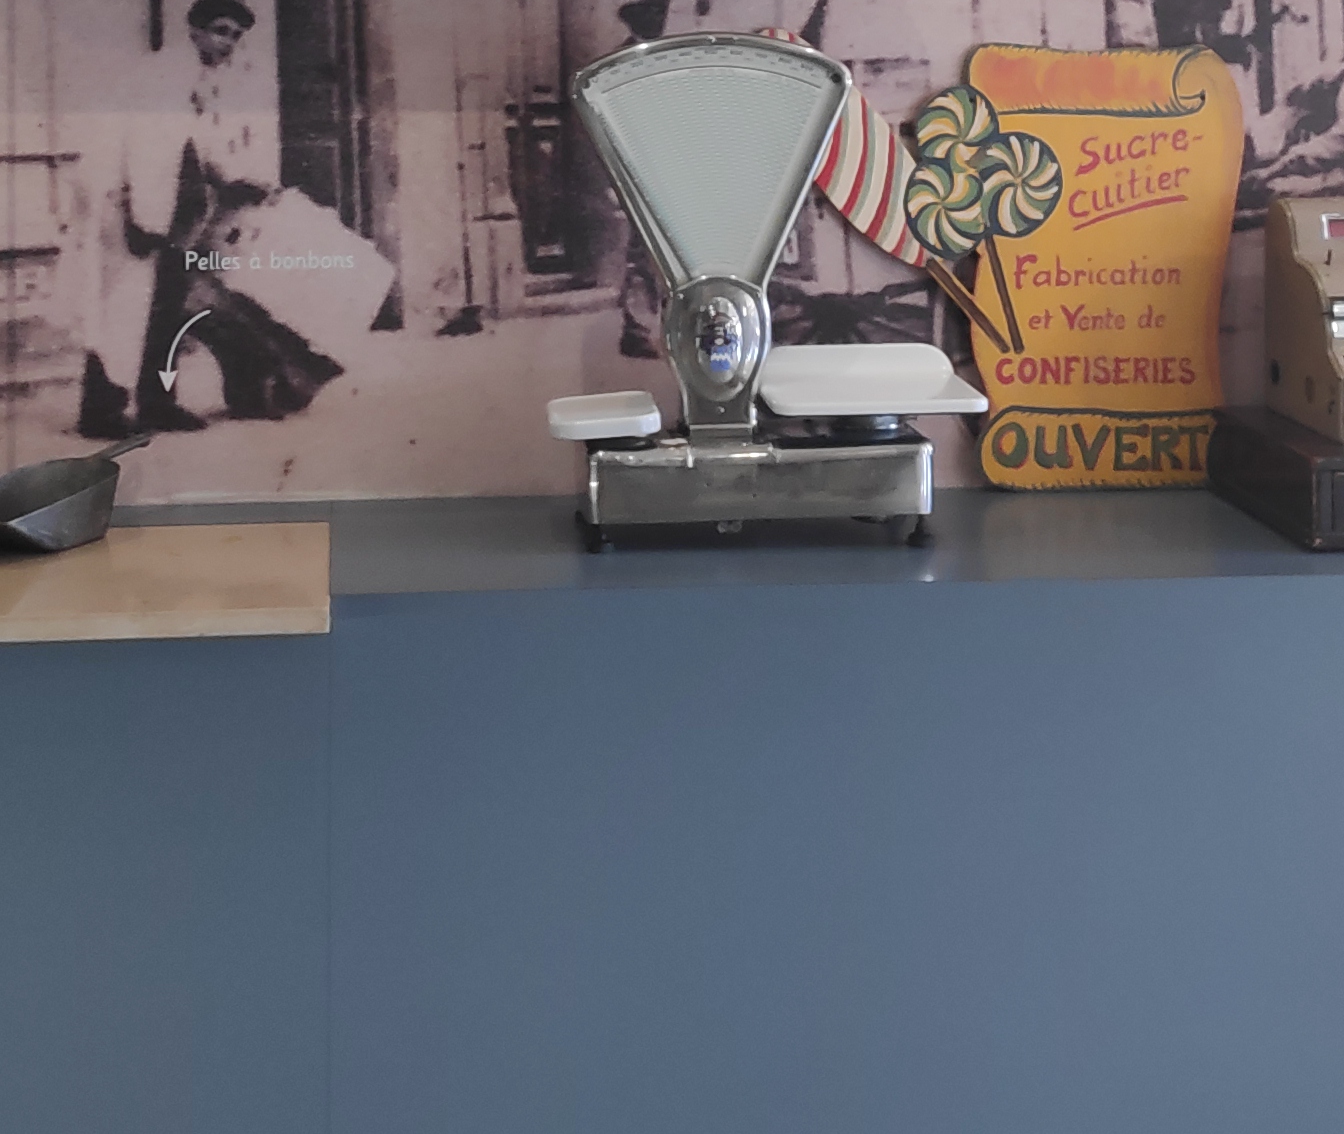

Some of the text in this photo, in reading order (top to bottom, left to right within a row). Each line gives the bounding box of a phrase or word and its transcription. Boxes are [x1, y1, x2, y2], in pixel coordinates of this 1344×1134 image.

[184, 250, 241, 271] Pelles
[270, 250, 354, 270] bonbons
[1013, 254, 1182, 290] Fabrication
[1028, 303, 1166, 331] et Vente de
[995, 356, 1197, 386] CONFISERIES
[992, 422, 1210, 474] OUVERT
